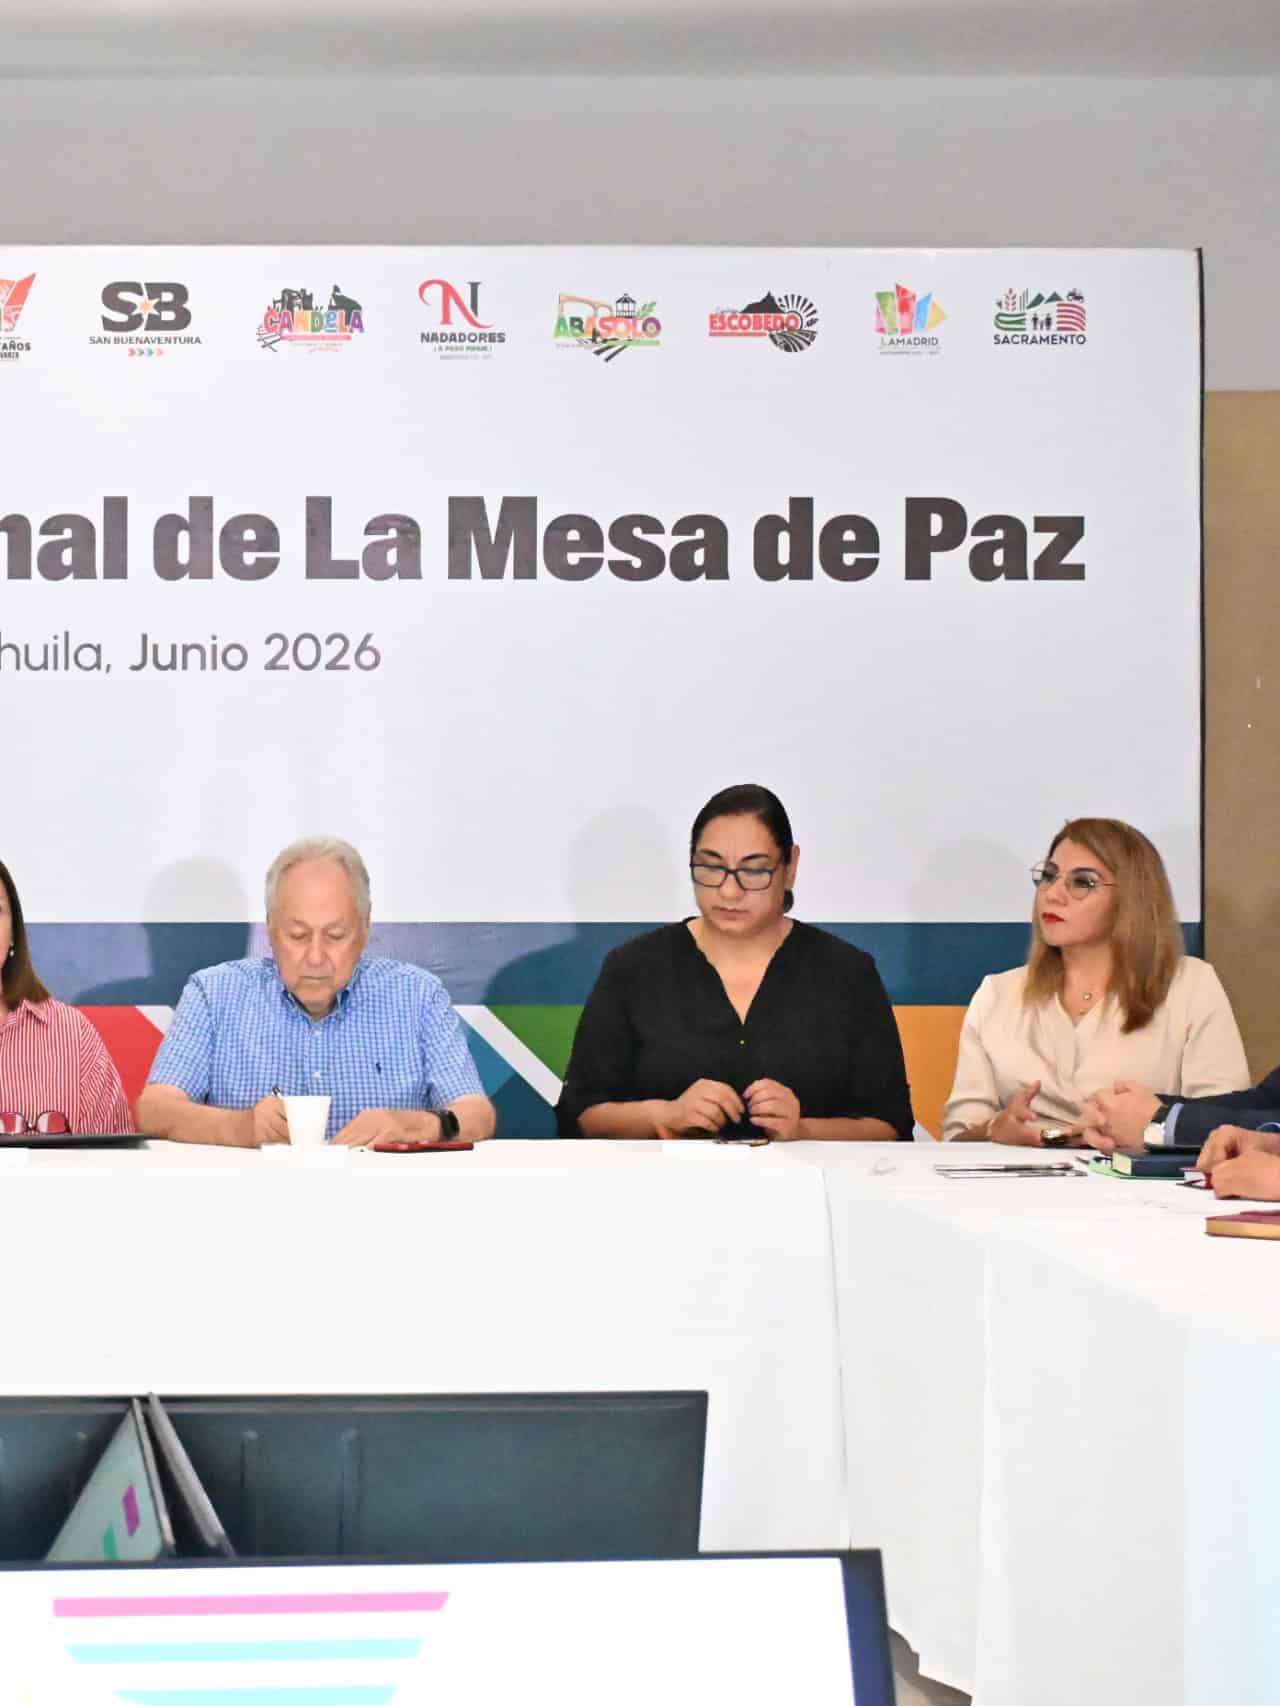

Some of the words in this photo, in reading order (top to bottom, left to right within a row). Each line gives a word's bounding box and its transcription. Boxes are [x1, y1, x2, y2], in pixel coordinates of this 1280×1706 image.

[554, 315, 662, 338] ABASOLO
[709, 312, 801, 331] ESCOBEDO
[89, 336, 111, 345] SAN
[114, 336, 202, 345] BUENAVENTURA
[420, 332, 506, 343] NADADORES
[881, 336, 939, 346] LAMADRID
[993, 334, 1087, 345] SACRAMENTO
[153, 495, 281, 582] de
[305, 495, 423, 581] La
[447, 495, 730, 582] Mesa
[752, 496, 881, 583] de
[904, 496, 1086, 582] Paz
[129, 633, 249, 672] Junio
[263, 633, 381, 672] 2026
